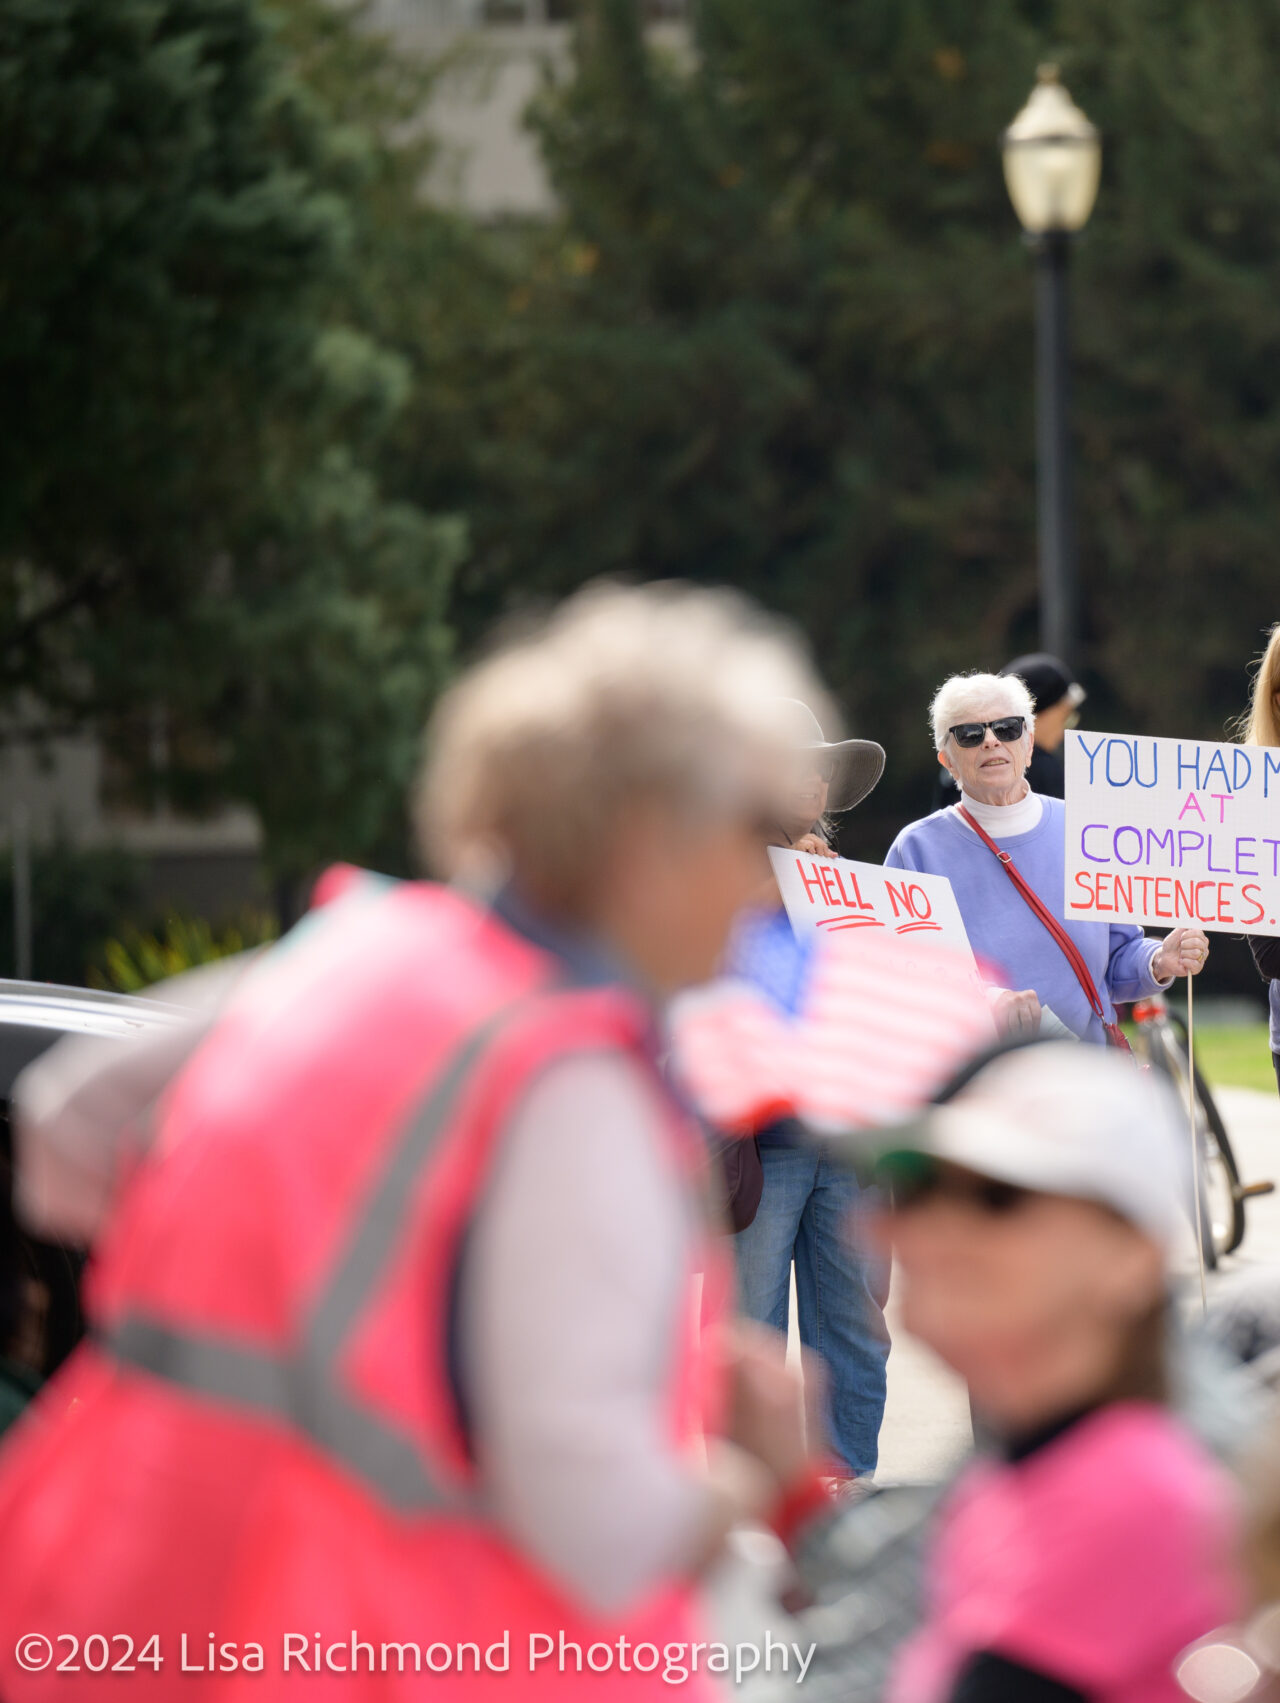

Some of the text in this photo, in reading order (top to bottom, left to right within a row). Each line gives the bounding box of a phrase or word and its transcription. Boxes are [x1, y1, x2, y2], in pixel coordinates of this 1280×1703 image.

[1077, 735, 1158, 789] YOU
[1177, 743, 1252, 794] HAD
[1178, 791, 1235, 823] AT
[795, 858, 933, 920] HELL NO
[1069, 870, 1277, 926] SENTENCES.
